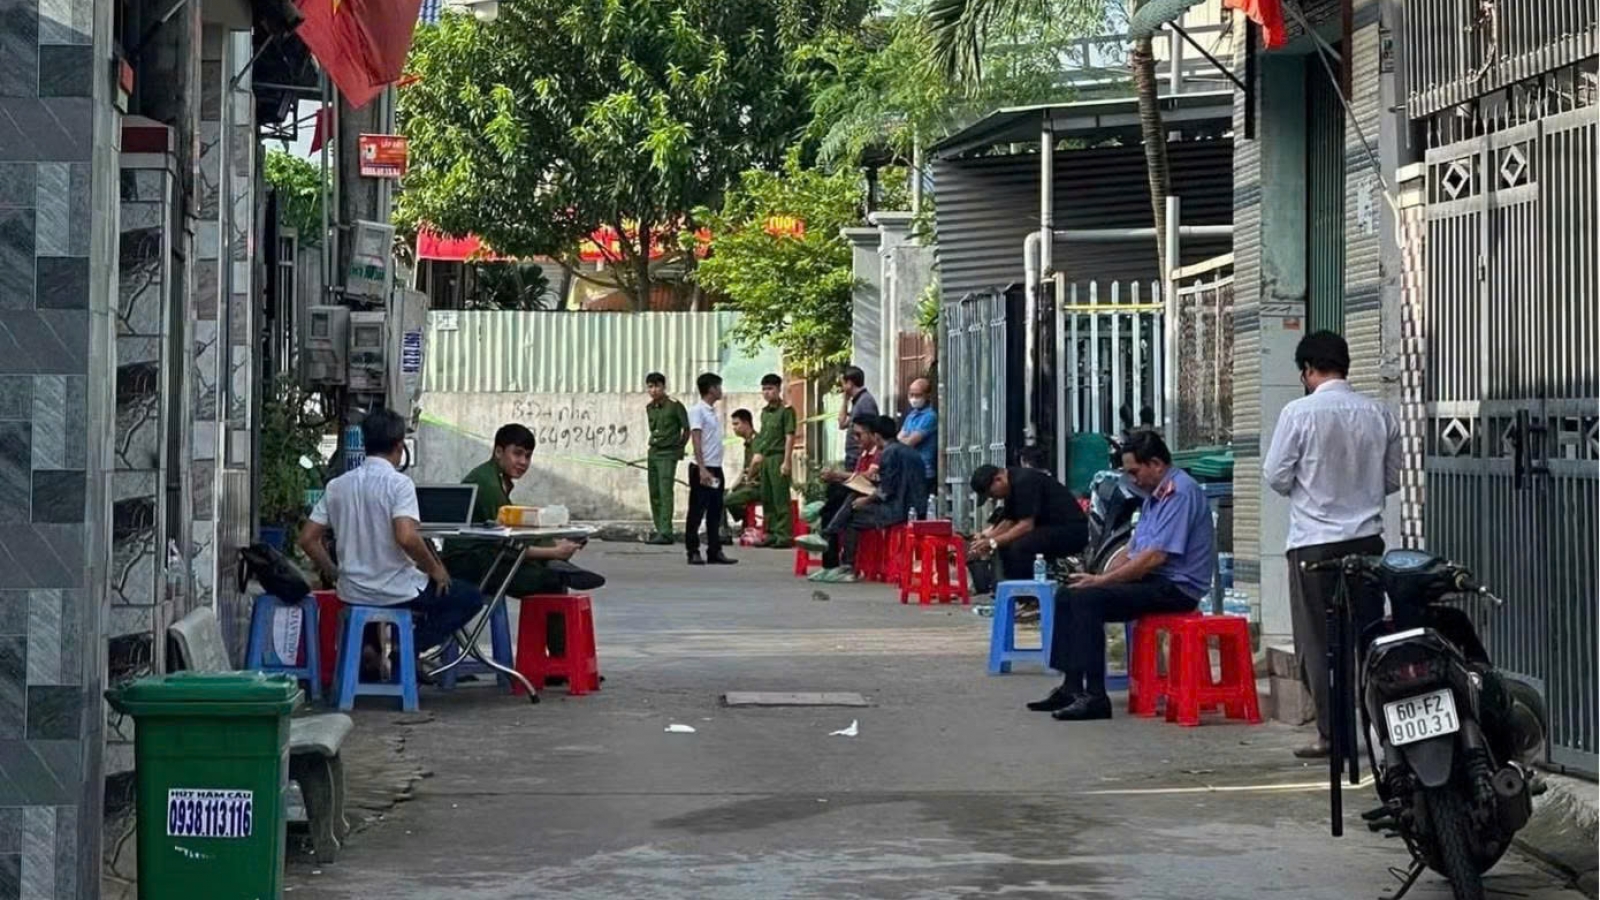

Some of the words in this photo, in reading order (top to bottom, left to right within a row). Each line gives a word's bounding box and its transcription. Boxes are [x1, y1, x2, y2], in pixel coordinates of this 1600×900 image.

[1396, 695, 1444, 721] 60-F2
[1394, 711, 1454, 741] 900.31
[169, 799, 251, 836] 0938.113.116
